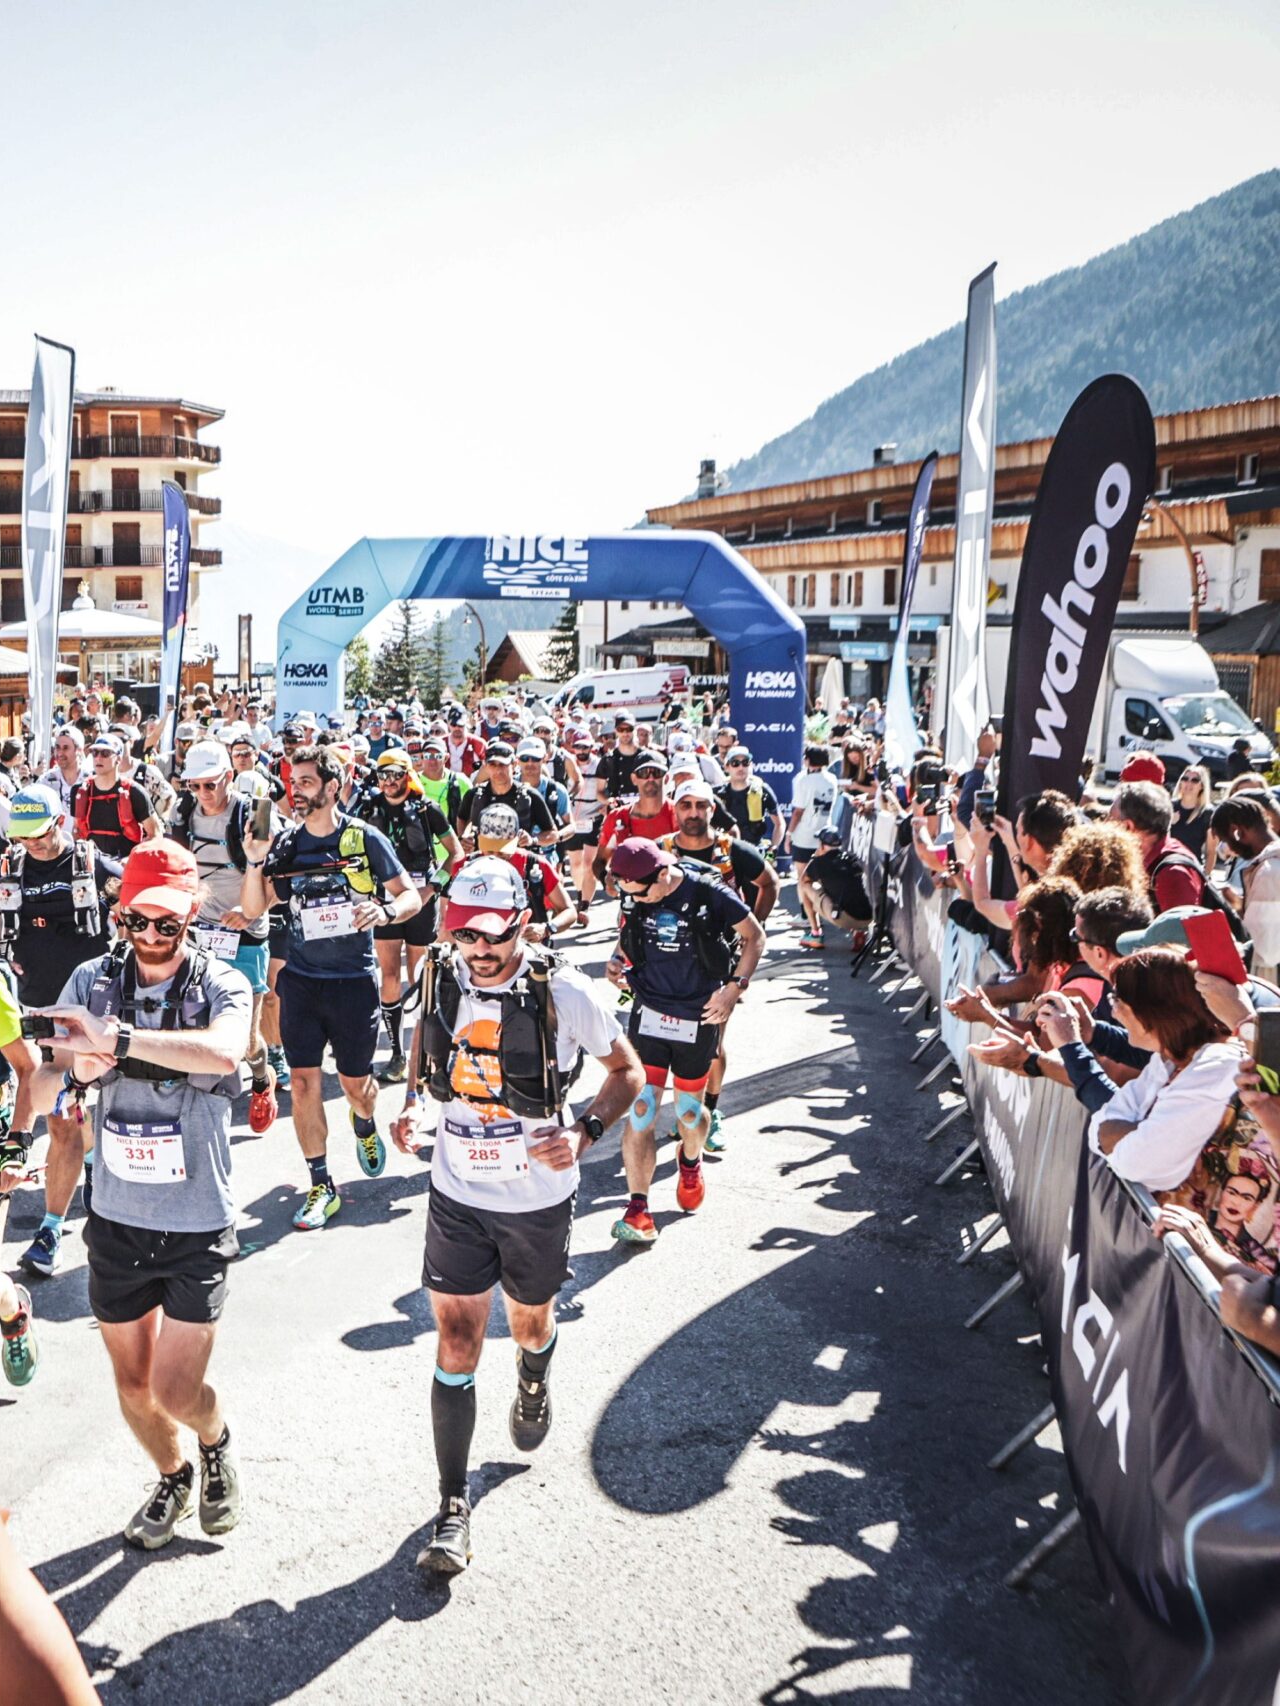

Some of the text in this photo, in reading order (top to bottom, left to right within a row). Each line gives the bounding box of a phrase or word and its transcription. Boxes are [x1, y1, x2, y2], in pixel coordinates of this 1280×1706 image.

[491, 536, 589, 561] NICE
[308, 587, 365, 604] UTMB
[308, 606, 362, 616] WORLD SERIES
[1028, 461, 1132, 760] wahoo
[283, 663, 329, 678] HOKA
[684, 674, 730, 686] LOCATION
[745, 671, 797, 689] HOKA
[745, 690, 756, 698] FLY
[757, 690, 783, 698] HUMAN
[744, 723, 797, 732] DACIA
[319, 913, 339, 922] 453
[116, 1137, 134, 1146] NICE
[124, 1147, 156, 1161] 331
[467, 1149, 501, 1161] 285
[128, 1163, 156, 1172] Dimitri
